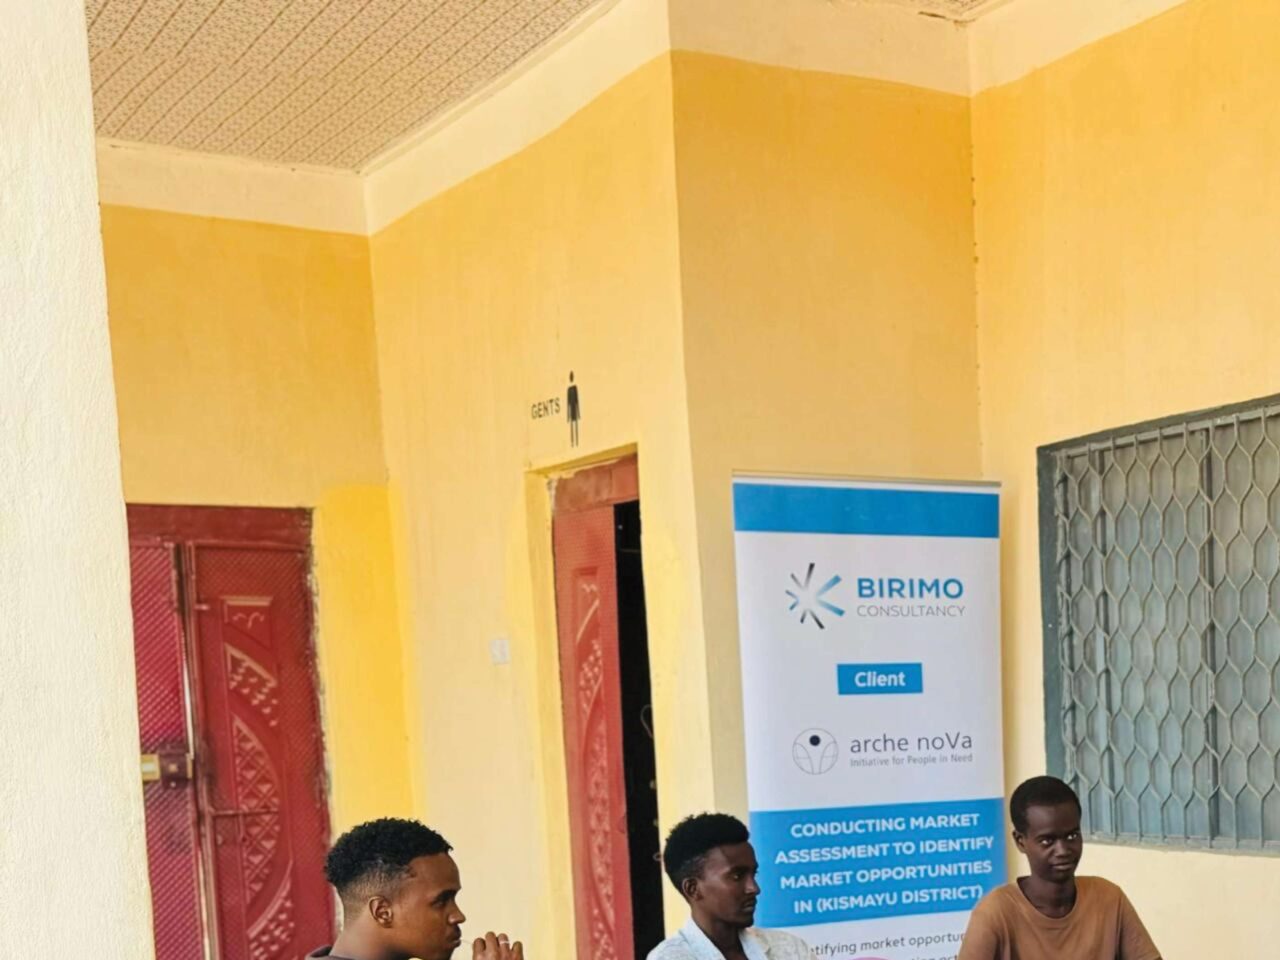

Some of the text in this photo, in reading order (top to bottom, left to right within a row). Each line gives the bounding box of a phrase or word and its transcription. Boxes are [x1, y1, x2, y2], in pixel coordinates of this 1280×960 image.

[531, 397, 560, 420] GENTS
[856, 577, 964, 599] BIRIMO
[856, 604, 966, 617] CONSULTANCY
[854, 671, 906, 687] Client
[850, 731, 973, 753] arche noVa
[850, 753, 974, 768] Initiative for People in Need
[790, 813, 980, 838] CONDUCTING MARKET
[774, 836, 995, 864] ASSESSMENT TO IDENTIFY
[780, 860, 993, 889] MARKET OPPORTUNITIES
[794, 884, 983, 914] IN (KISMAYU DISTRICT)
[811, 942, 857, 956] tifying
[860, 937, 905, 951] market
